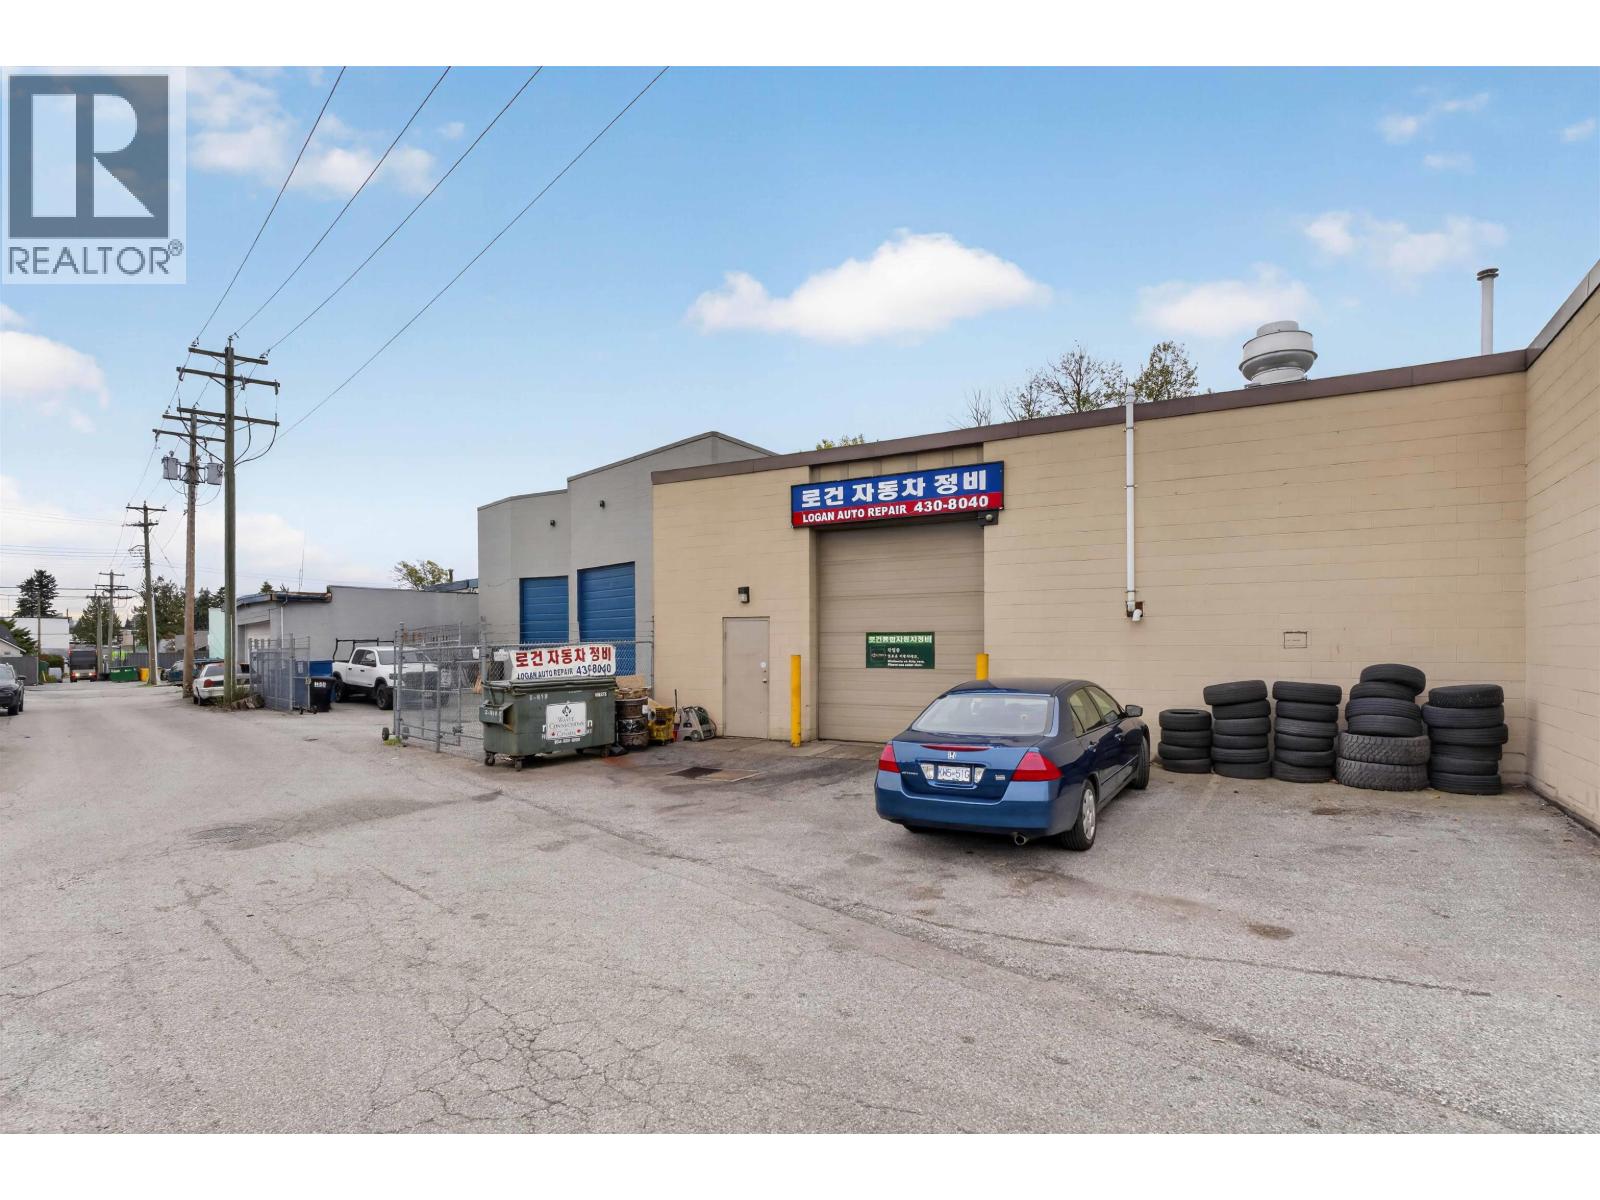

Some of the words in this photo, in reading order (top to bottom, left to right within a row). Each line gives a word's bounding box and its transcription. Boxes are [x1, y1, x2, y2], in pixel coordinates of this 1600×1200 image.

[801, 487, 844, 508] 로건
[852, 477, 926, 502] 자동차
[934, 469, 987, 495] 정비
[802, 511, 835, 523] LOGAN
[837, 508, 865, 520] AUTO
[868, 504, 907, 517] REPAIR
[913, 495, 989, 513] 430-8040
[515, 650, 544, 668] 로건
[547, 647, 586, 666] 자동차
[589, 646, 611, 662] 정비
[538, 669, 553, 678] AUTO
[553, 667, 574, 677] REPAIR
